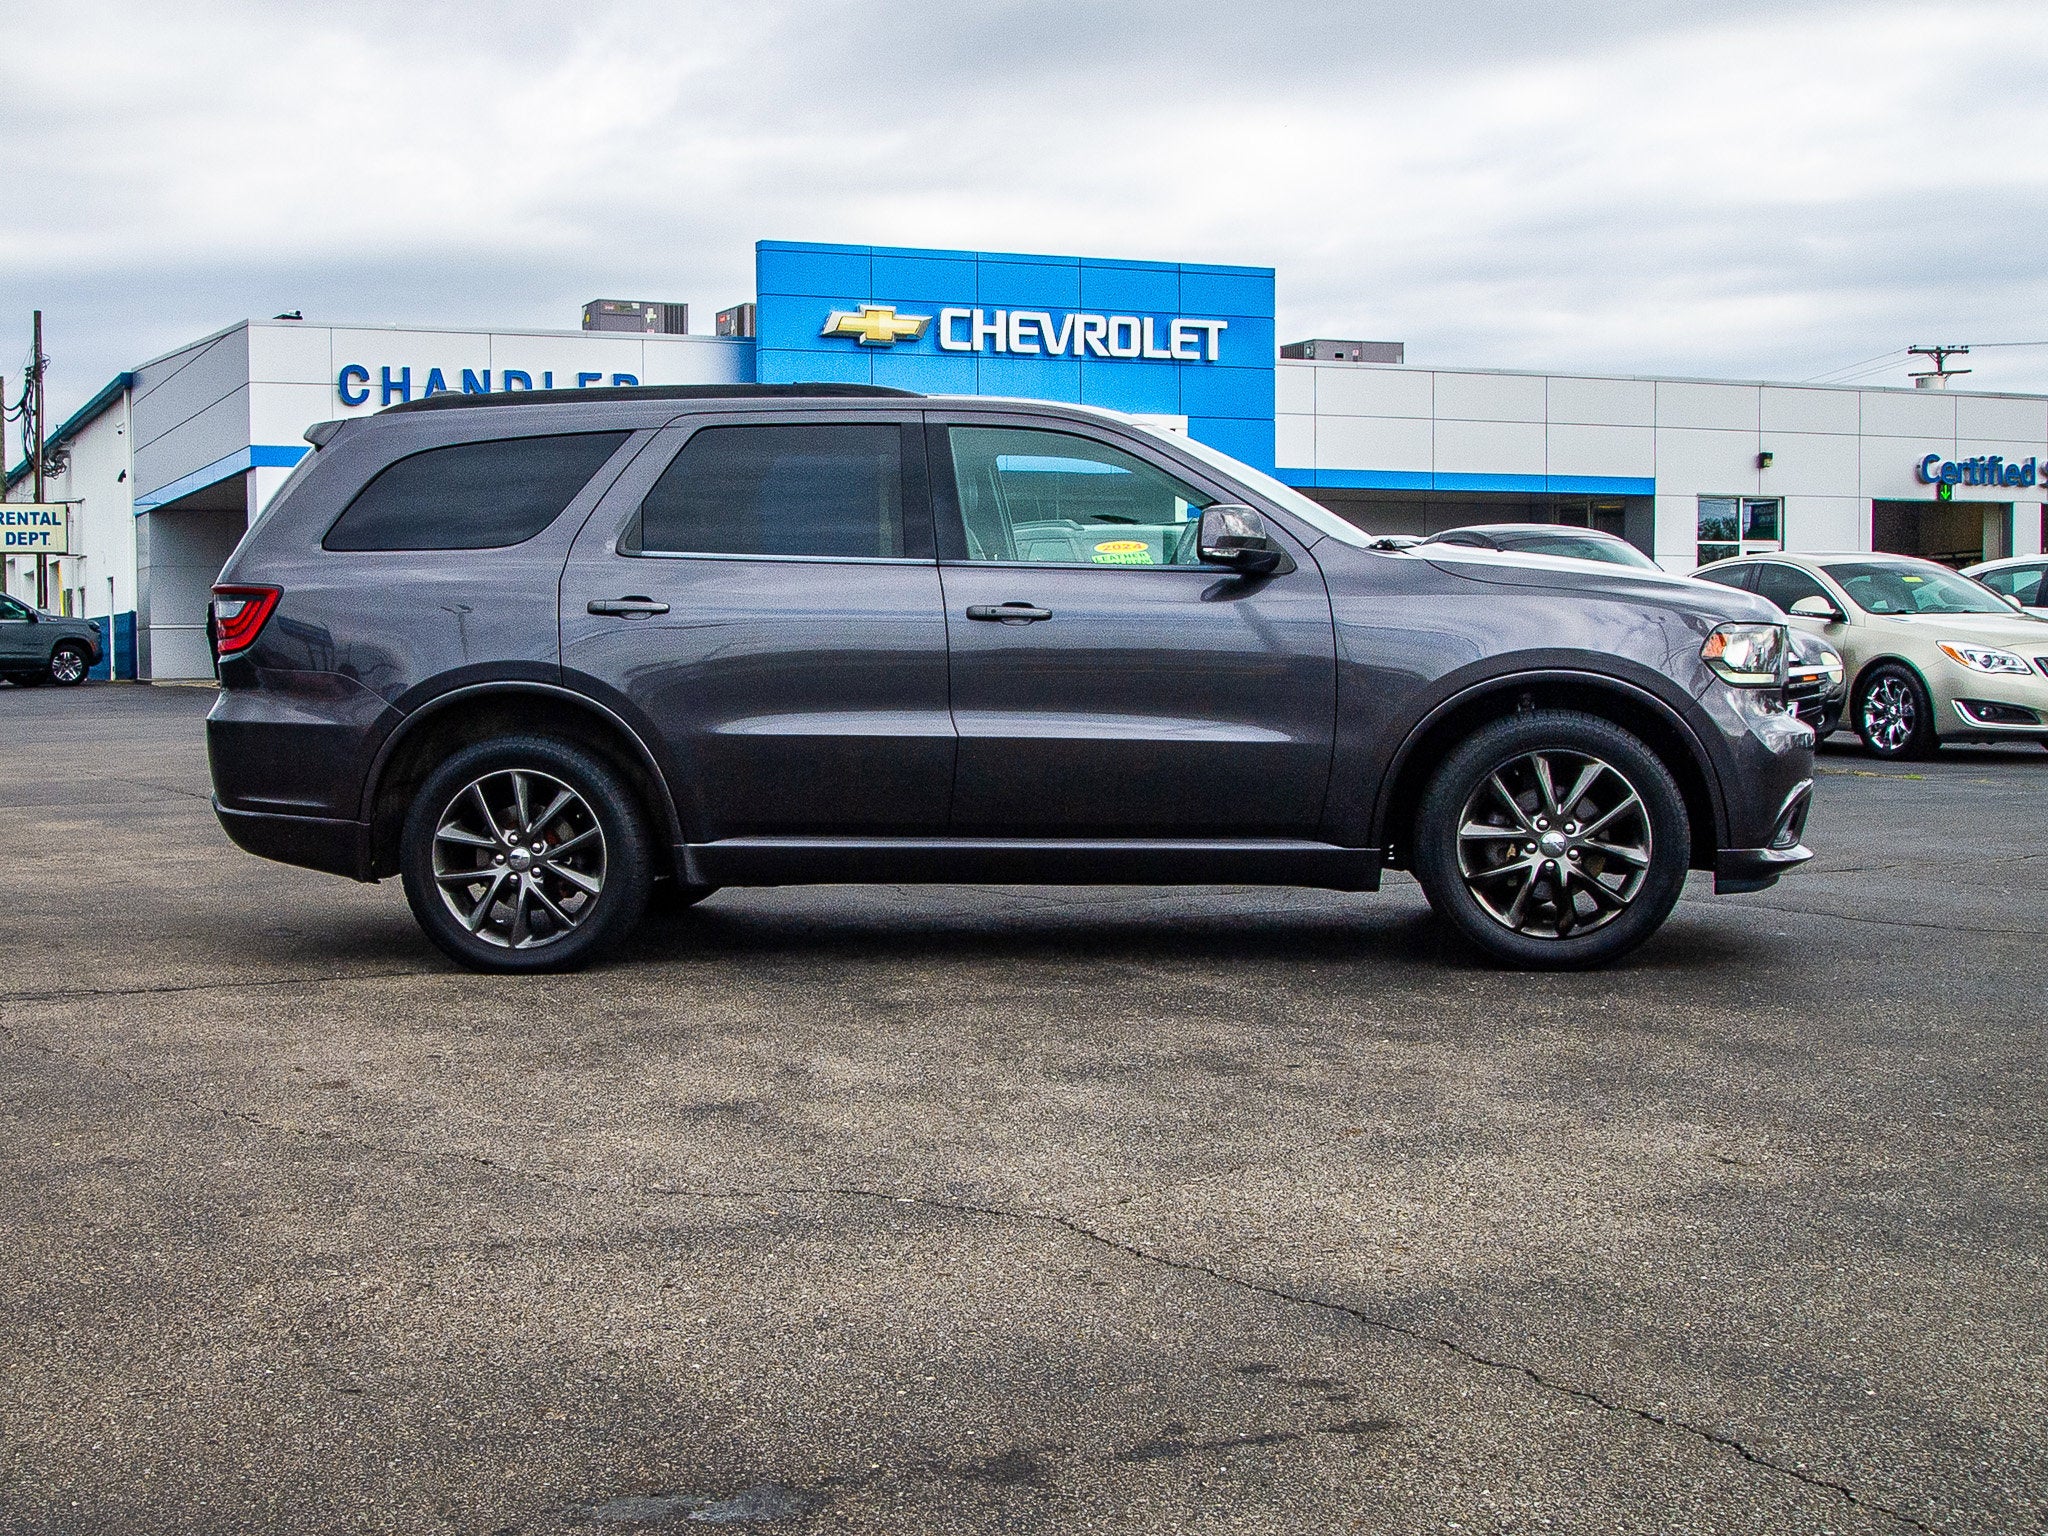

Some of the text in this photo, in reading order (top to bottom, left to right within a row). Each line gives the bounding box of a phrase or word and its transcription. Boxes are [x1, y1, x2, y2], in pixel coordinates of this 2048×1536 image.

[939, 307, 1228, 361] CHEVROLET
[338, 364, 639, 406] CHAND
[1920, 453, 2036, 487] Certified
[5, 531, 51, 546] DEPT.
